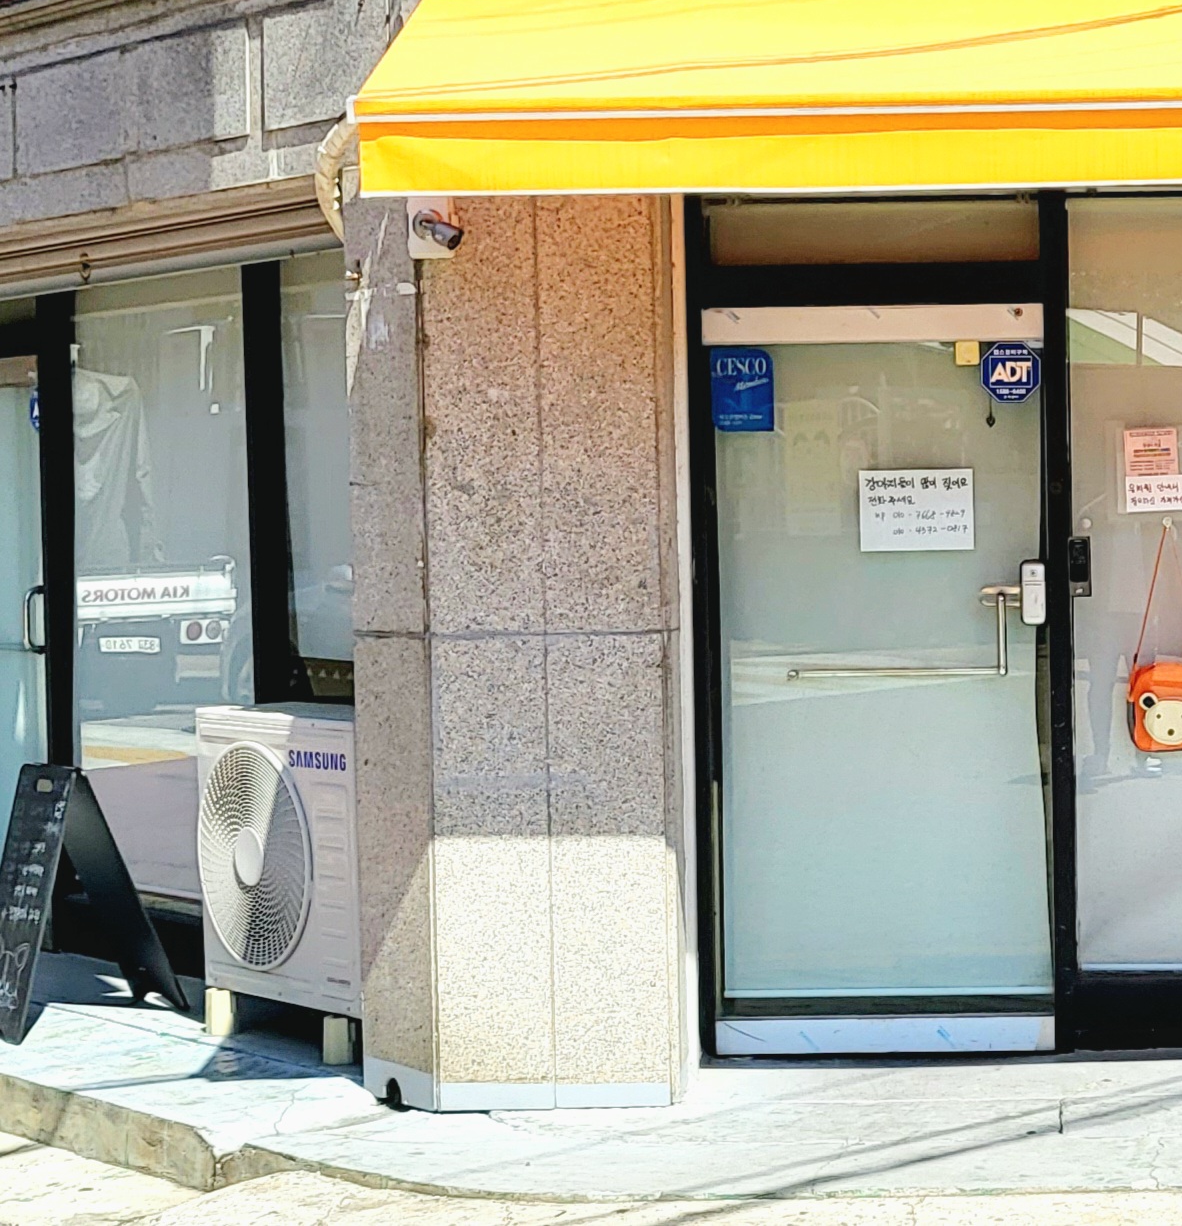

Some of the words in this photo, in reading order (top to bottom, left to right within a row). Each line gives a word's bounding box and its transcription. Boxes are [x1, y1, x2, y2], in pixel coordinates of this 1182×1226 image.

[716, 357, 767, 376] CESCO
[991, 361, 1031, 383] ADT
[288, 750, 347, 771] SAMSUNG
